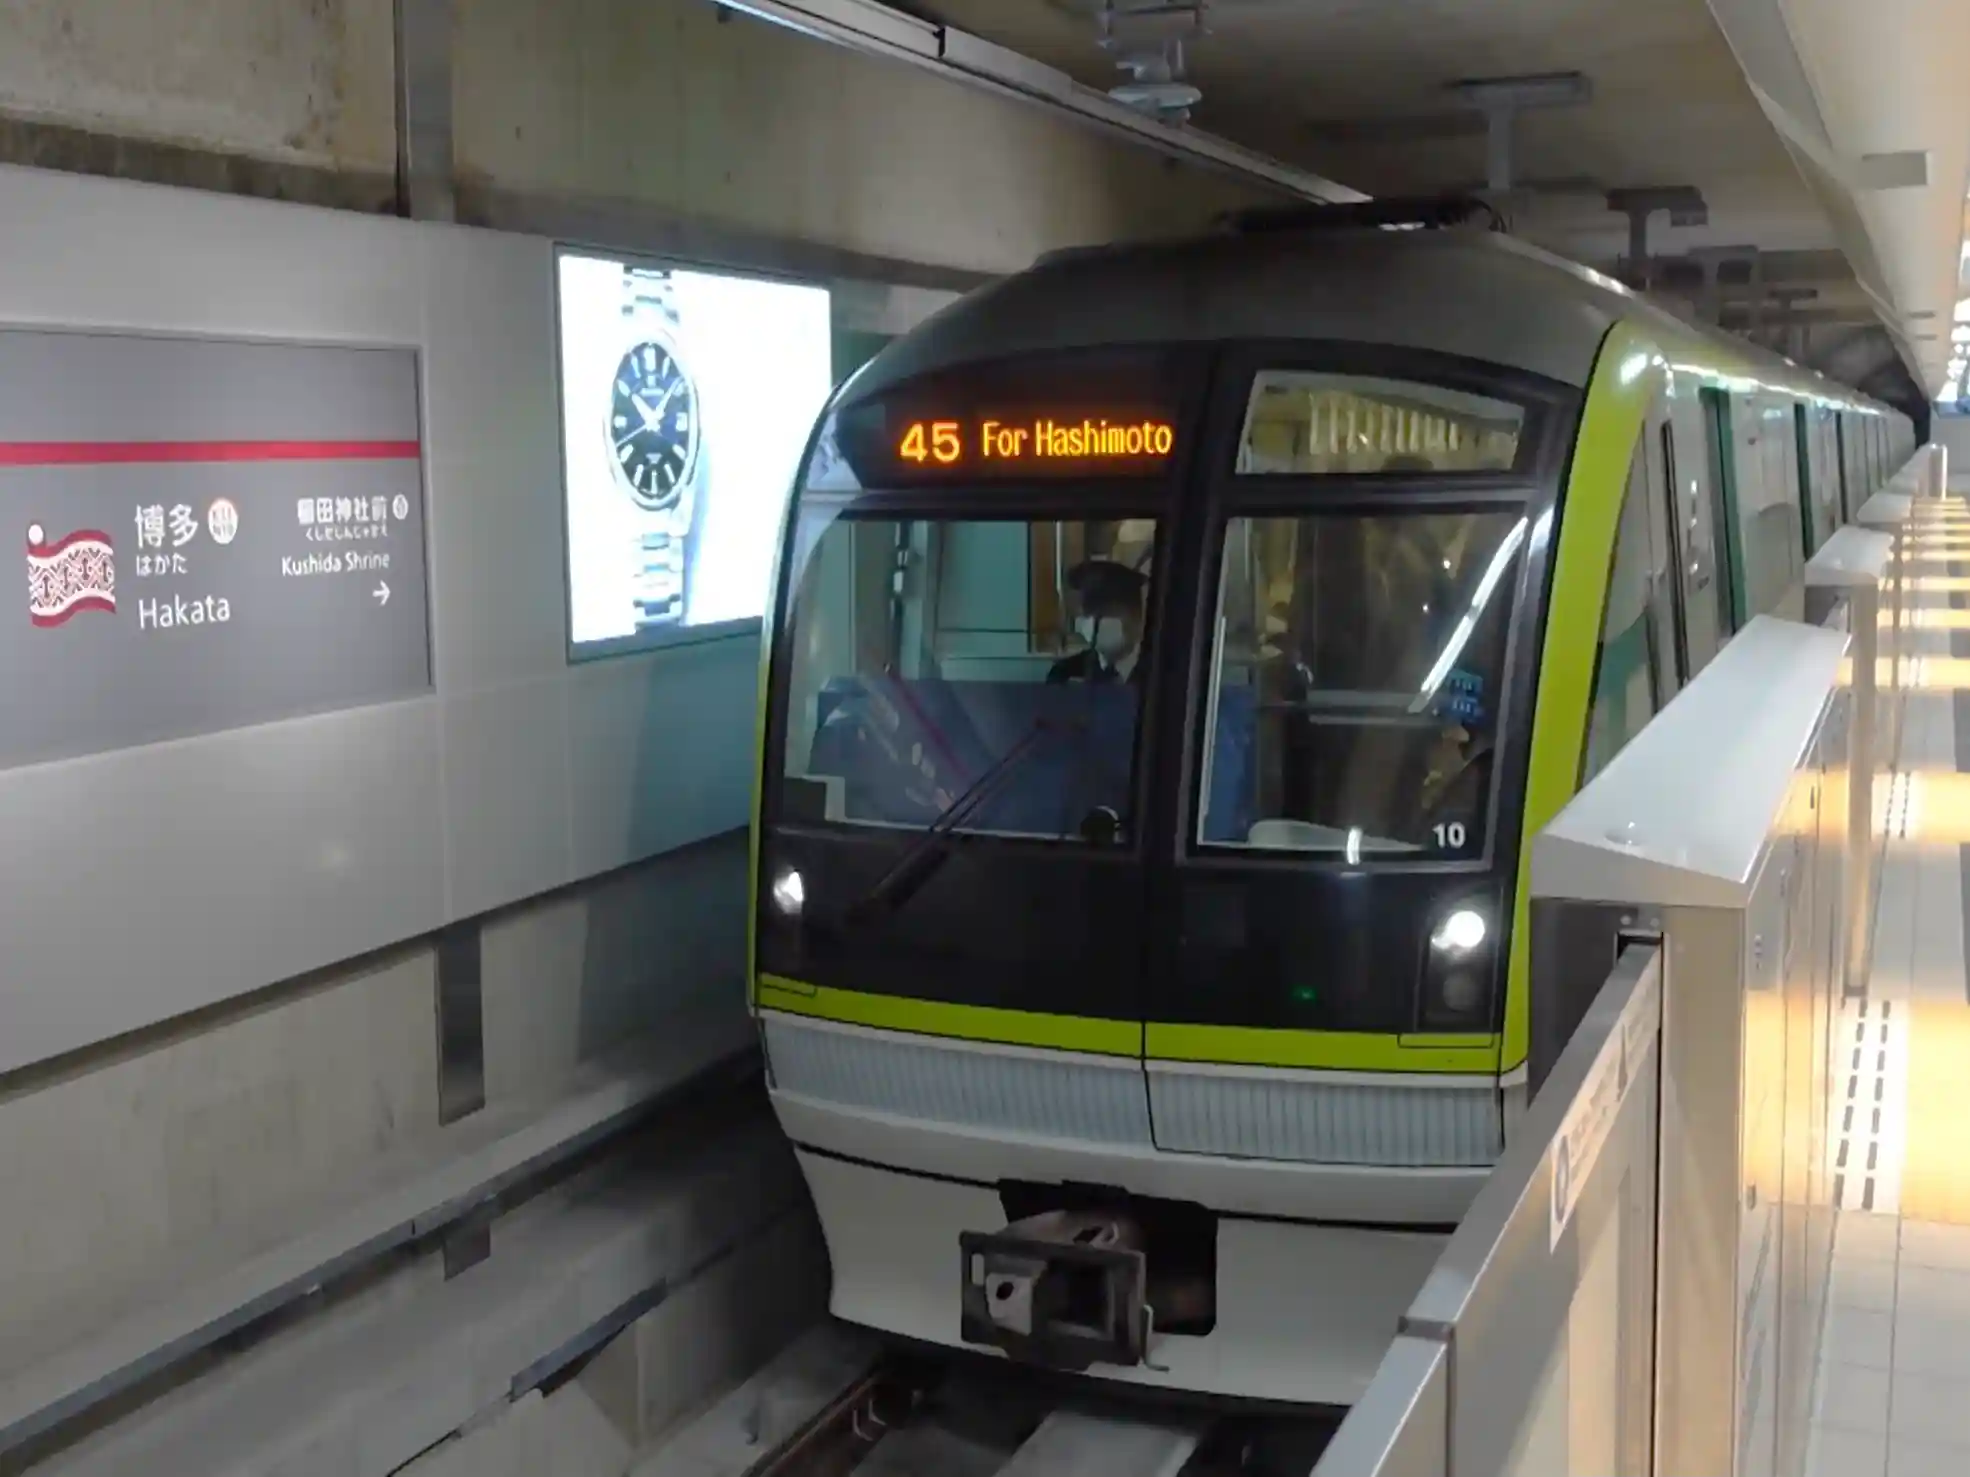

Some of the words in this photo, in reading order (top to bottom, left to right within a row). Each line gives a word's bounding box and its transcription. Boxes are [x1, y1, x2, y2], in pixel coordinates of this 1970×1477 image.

[900, 422, 960, 462] 45
[982, 420, 1028, 457] For
[1035, 419, 1172, 457] Hashimoto
[135, 503, 198, 549] 博多
[136, 552, 188, 577] はかた
[281, 551, 342, 576] Kushida
[345, 549, 390, 572] Shrine
[138, 593, 230, 629] Hakata
[1431, 821, 1466, 848] 10
